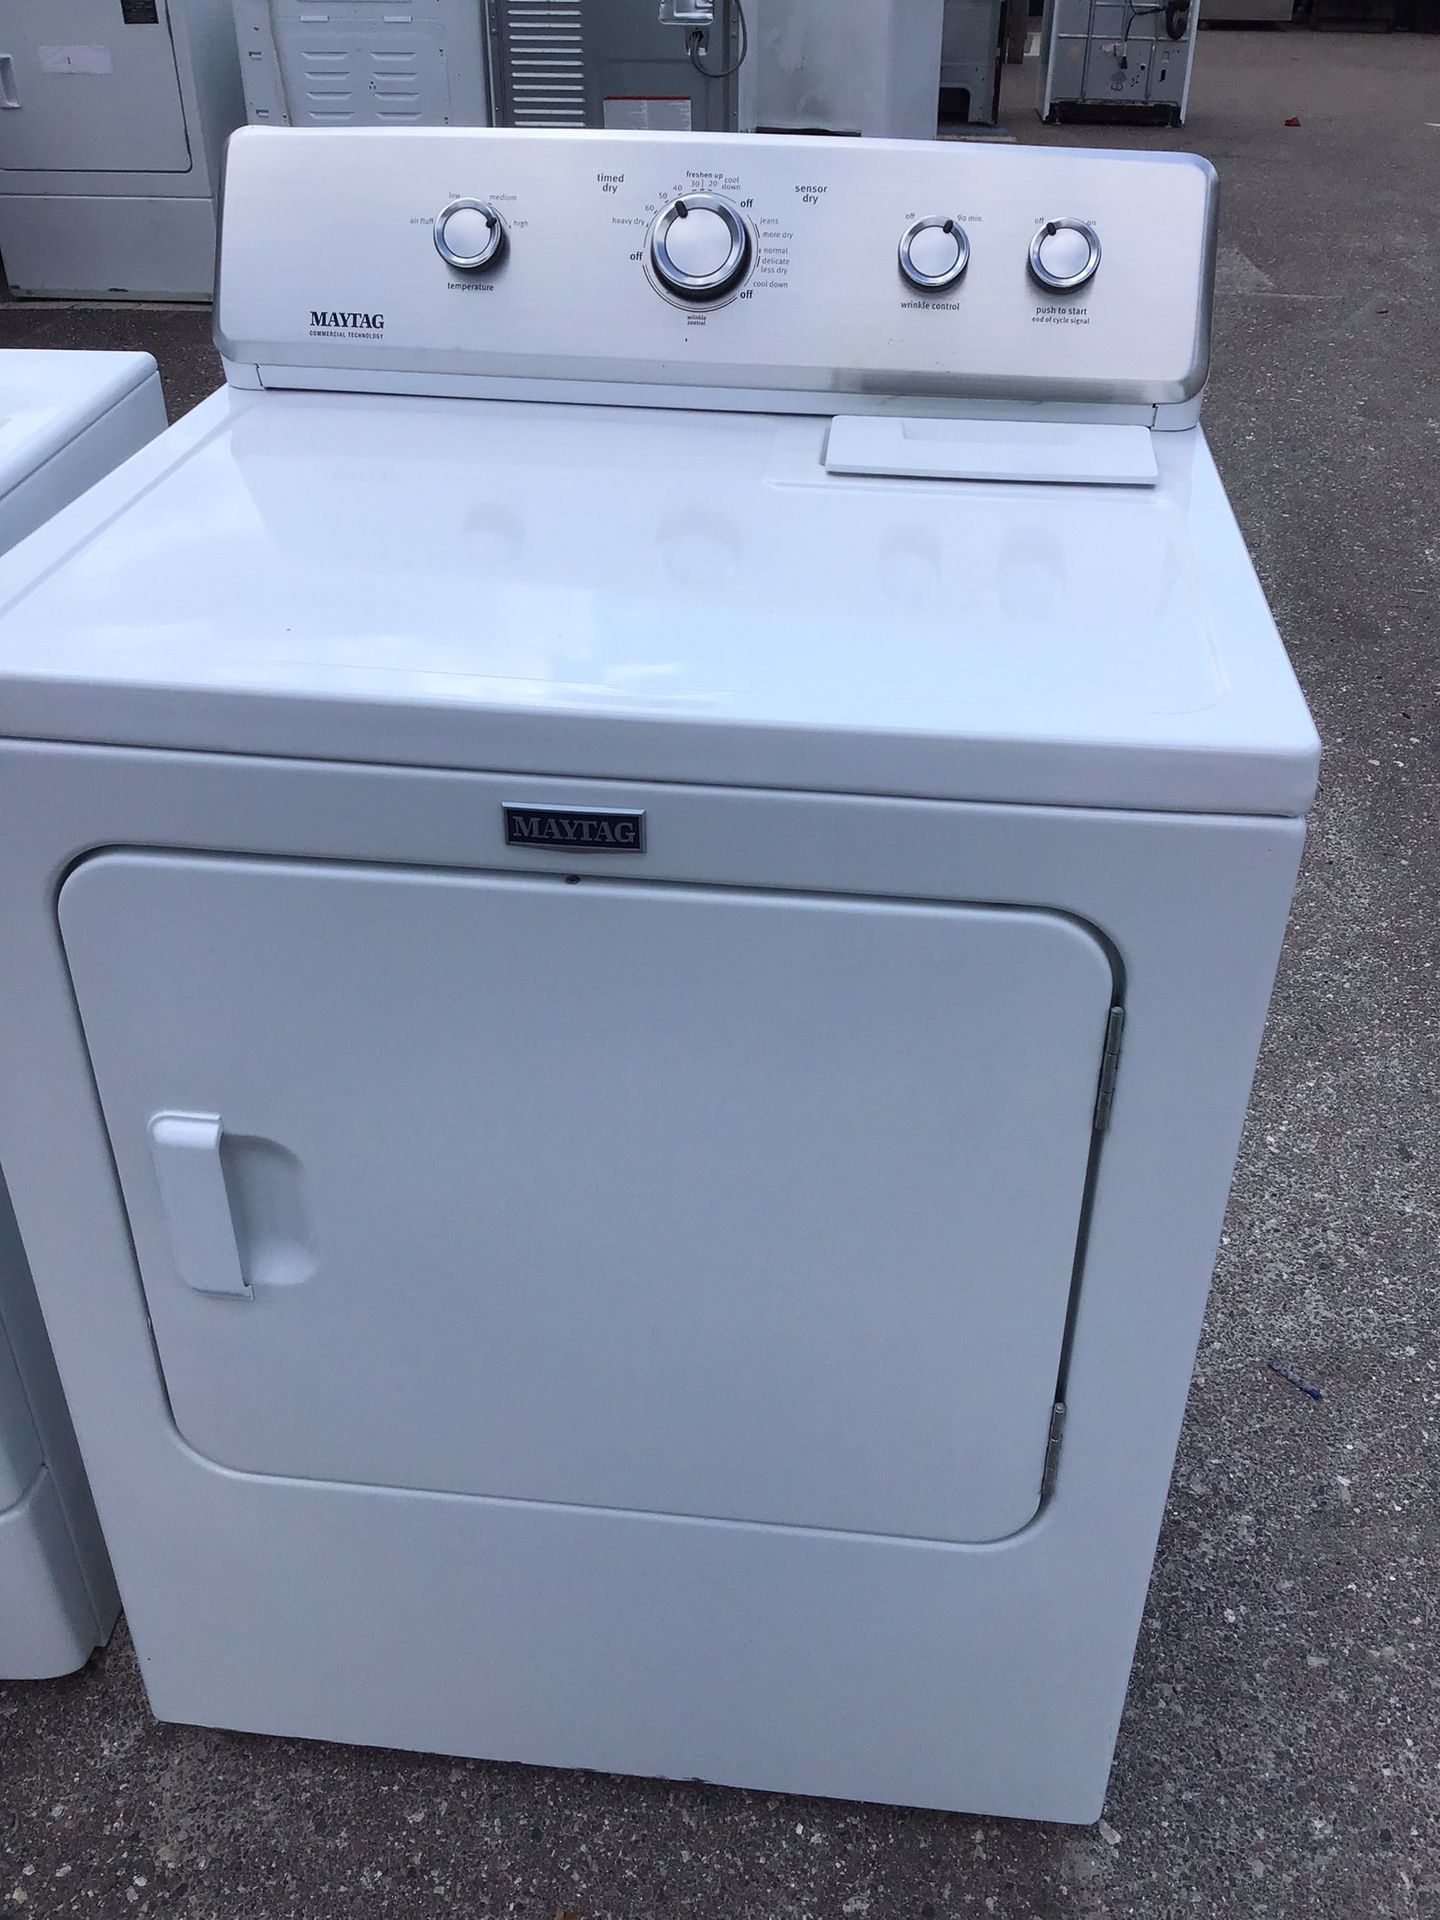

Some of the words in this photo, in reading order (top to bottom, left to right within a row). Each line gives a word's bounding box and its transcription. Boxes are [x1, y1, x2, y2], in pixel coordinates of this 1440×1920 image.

[597, 173, 624, 183] timed
[686, 171, 713, 179] freshen
[602, 183, 618, 194] dry
[795, 185, 828, 193] sensor
[448, 192, 461, 200] low
[489, 193, 517, 201] medium
[802, 193, 819, 205] dry
[740, 199, 754, 208] off
[905, 212, 915, 220] off
[957, 214, 967, 222] 90
[410, 217, 419, 225] air
[513, 220, 529, 228] high
[612, 217, 633, 225] heavy
[633, 218, 645, 226] dry
[760, 217, 779, 225] jeans
[762, 231, 780, 239] more
[782, 231, 793, 240] dry
[763, 247, 788, 255] normal
[629, 252, 643, 261] off
[761, 257, 790, 265] delicate
[761, 266, 775, 274] less
[776, 266, 788, 275] dry
[447, 282, 494, 292] temperature
[753, 280, 767, 288] cool
[768, 280, 788, 288] down
[740, 290, 754, 299] off
[900, 301, 930, 310] wrinkle
[931, 302, 960, 311] control
[1036, 306, 1056, 315] push
[1058, 307, 1067, 315] to
[1068, 307, 1087, 315] start
[309, 311, 385, 329] MAYTAG
[1052, 317, 1070, 325] cycle
[1070, 317, 1090, 325] signal
[309, 330, 346, 338] COMMERCIAL
[512, 816, 636, 844] MAYTAG
